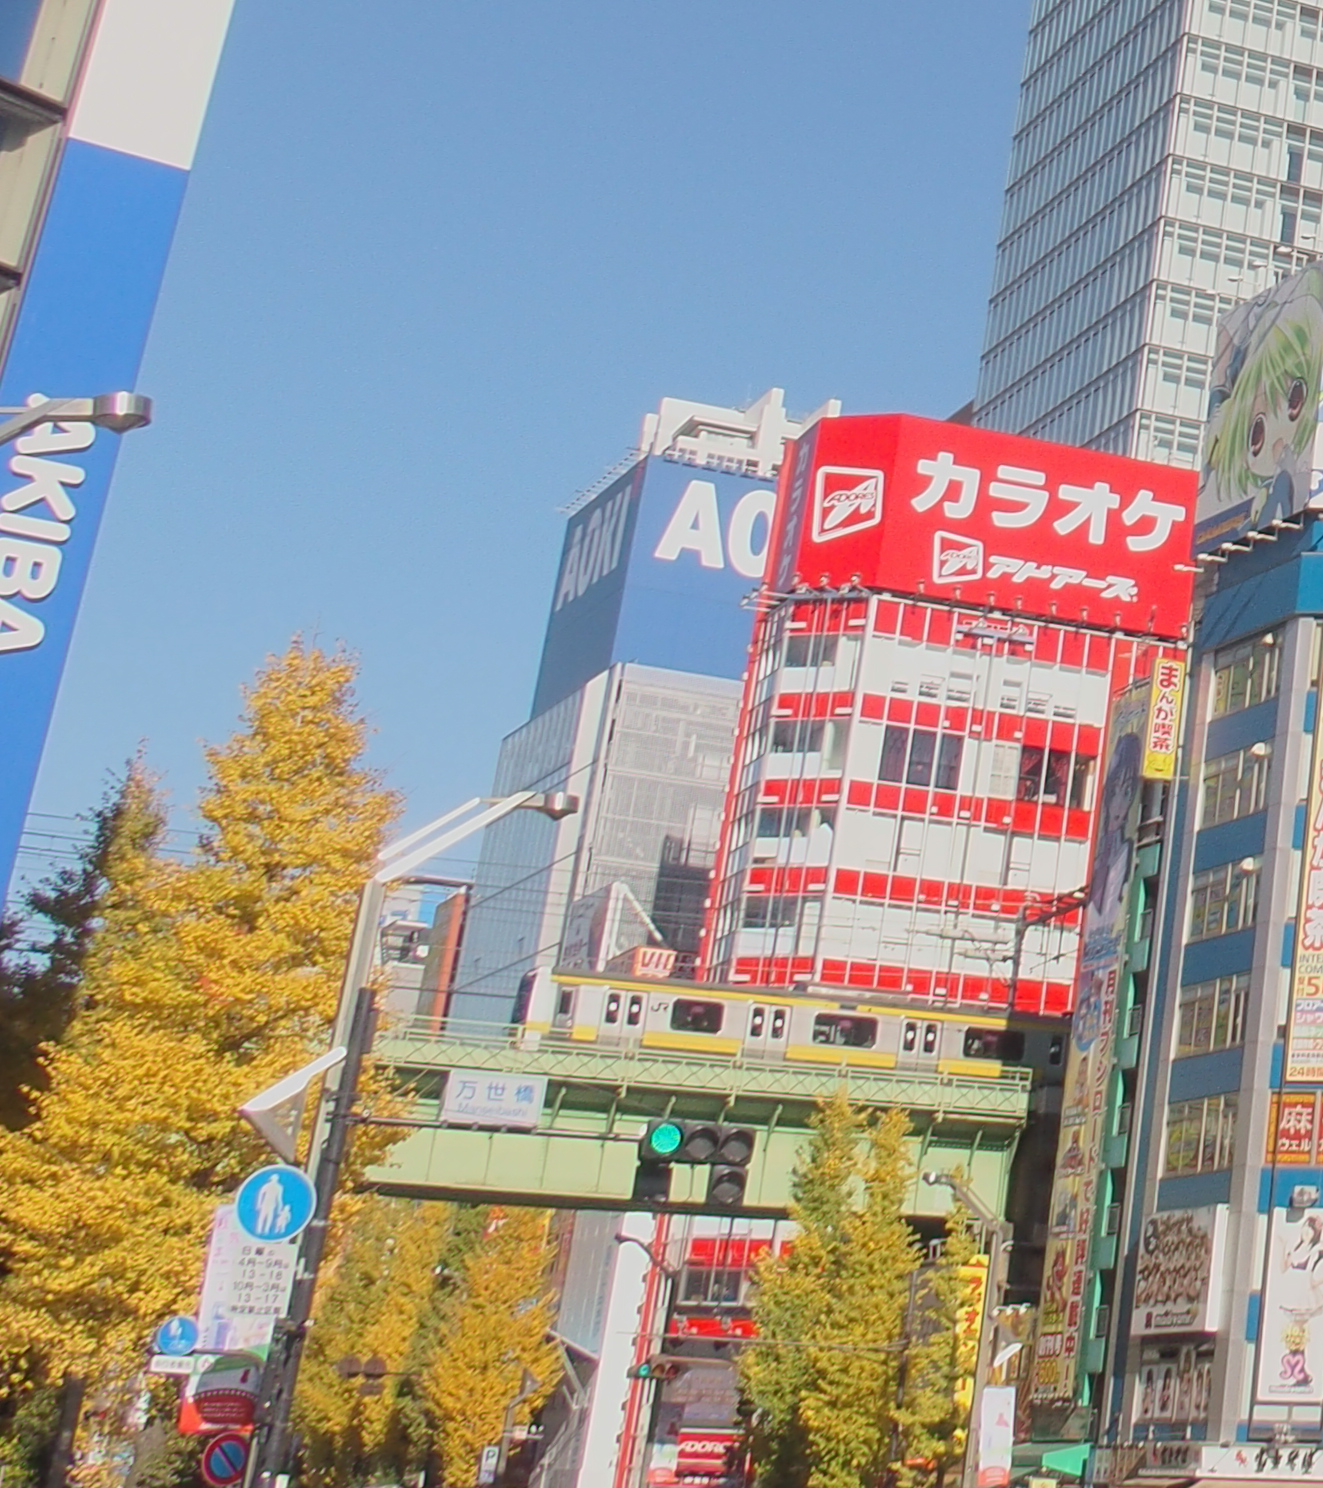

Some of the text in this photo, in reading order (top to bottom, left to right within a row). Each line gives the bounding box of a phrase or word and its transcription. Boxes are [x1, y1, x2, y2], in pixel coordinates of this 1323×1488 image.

[822, 488, 878, 509] ADORES
[910, 450, 1187, 553] カラオケ
[553, 484, 633, 613] AOKI
[987, 555, 1139, 602] アドアーズ
[1151, 665, 1179, 753] まんが喫茶
[455, 1080, 535, 1105] 万世橋
